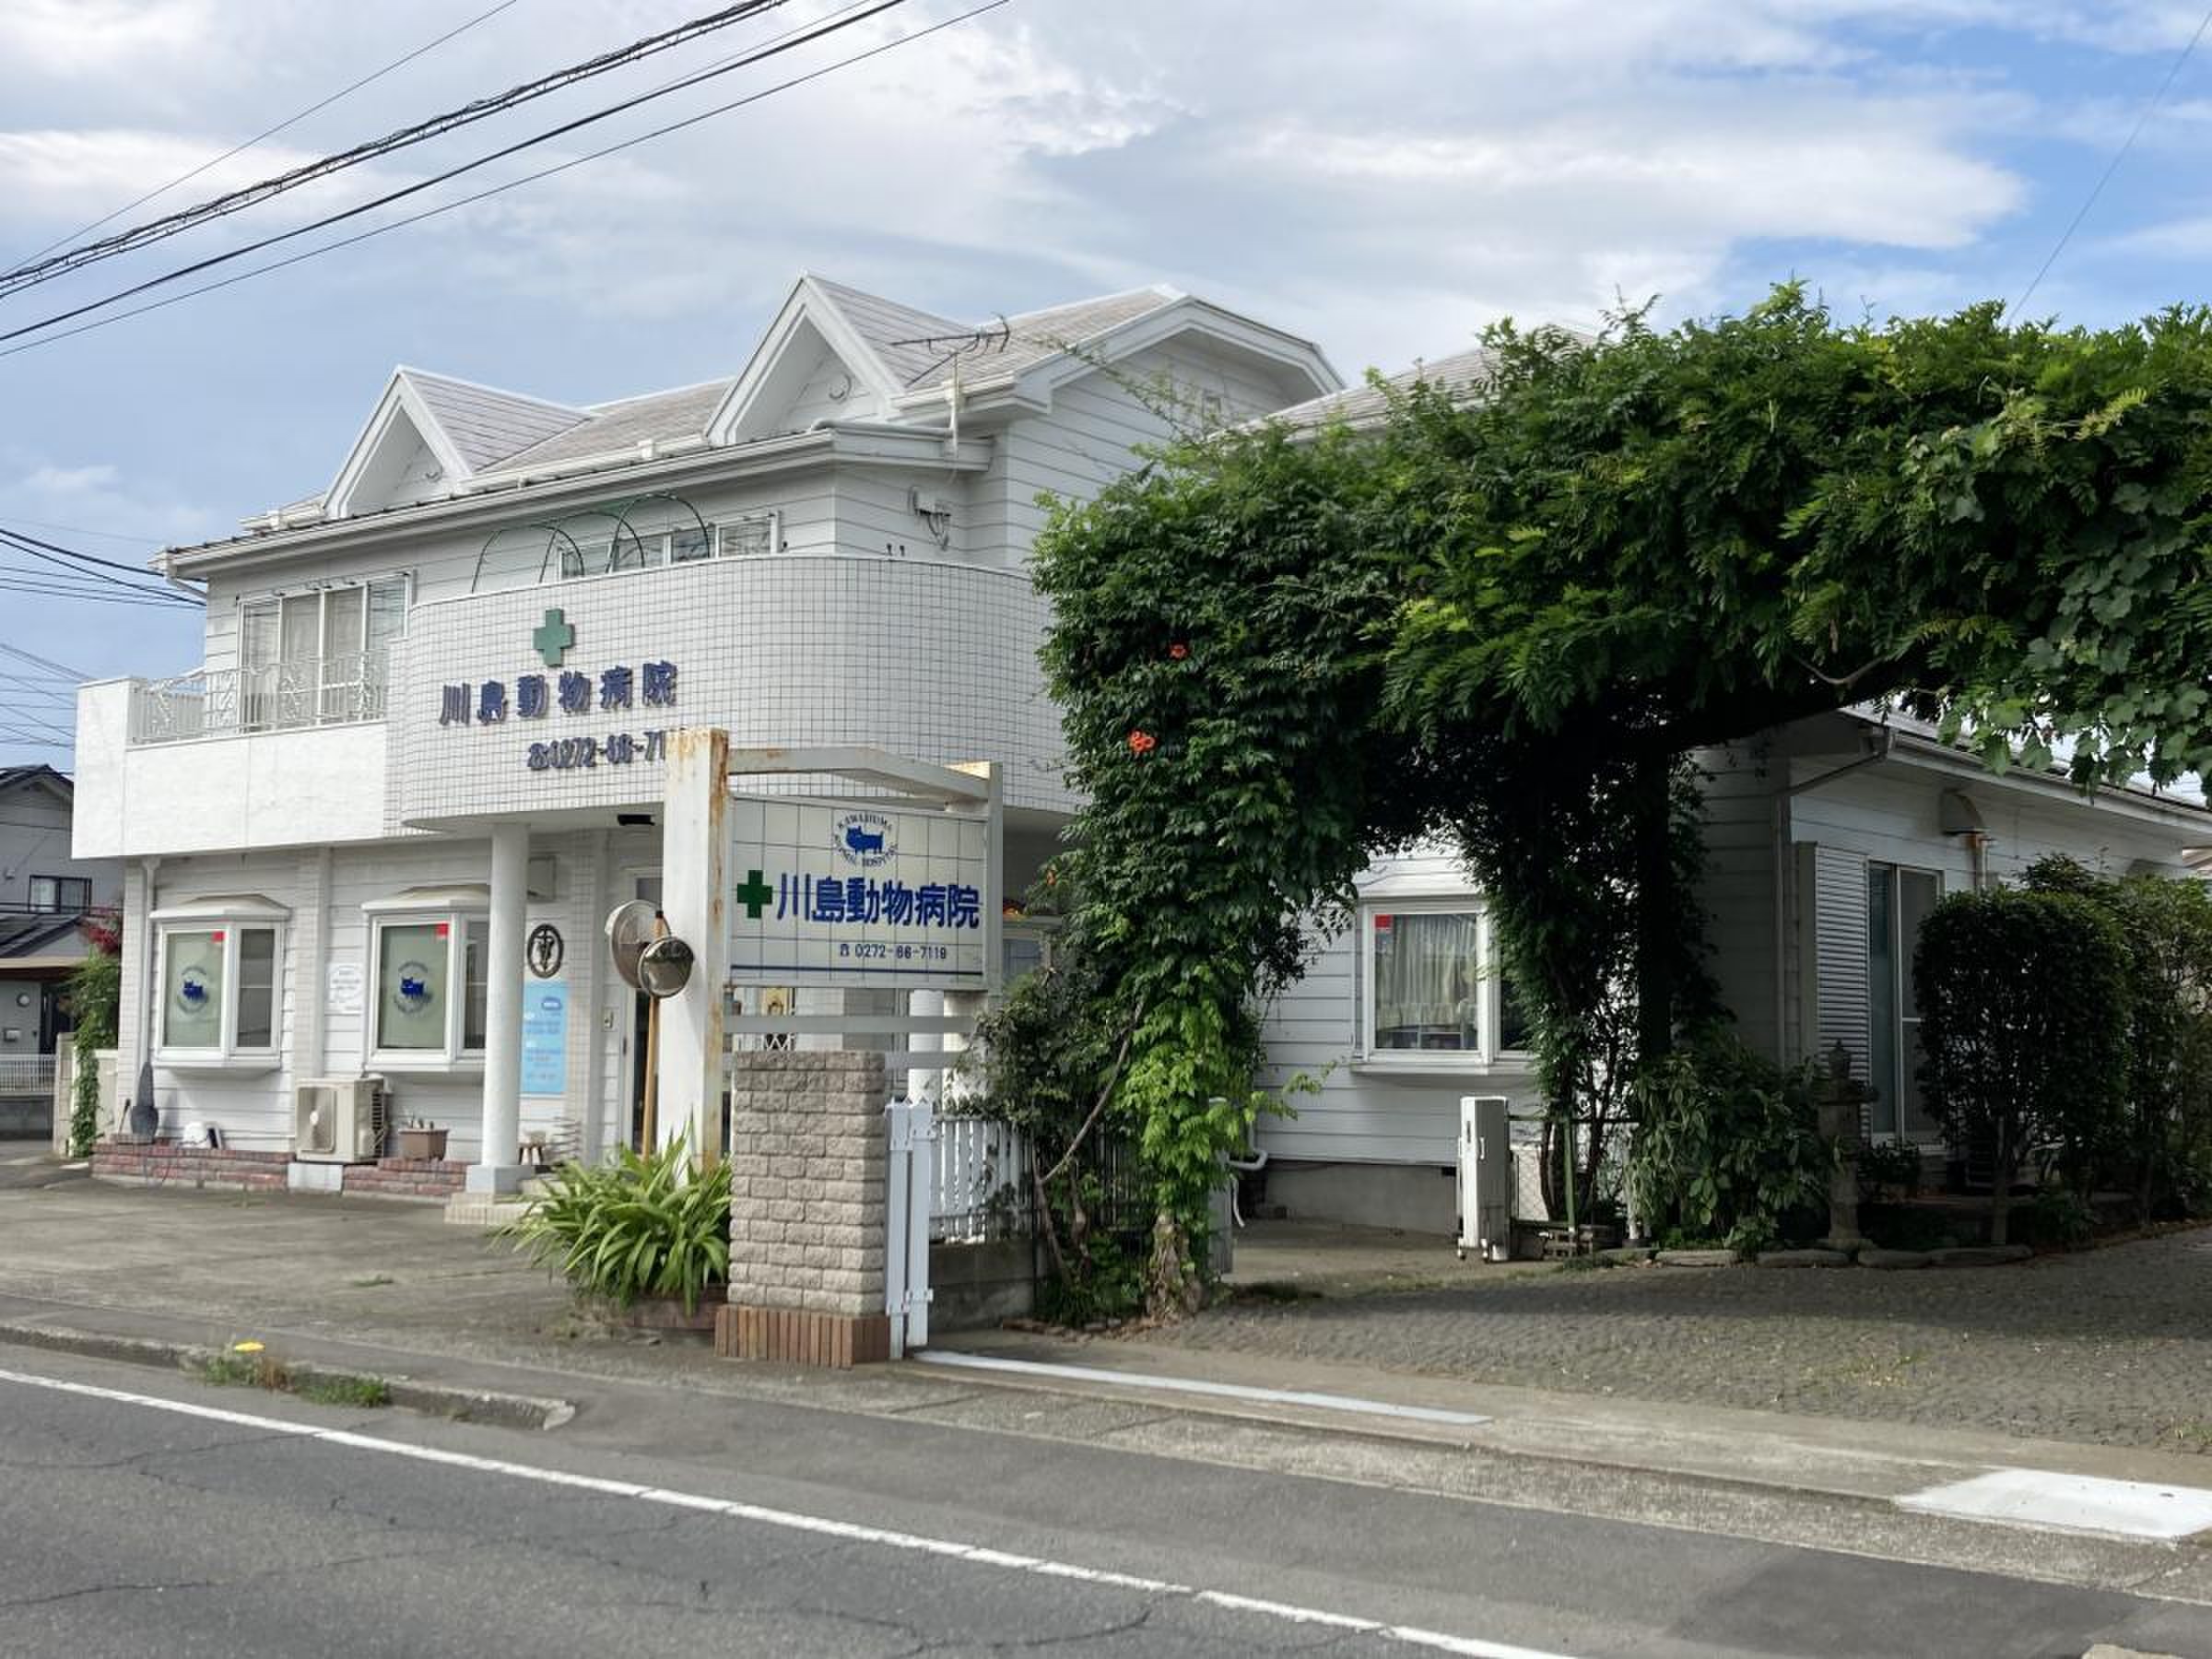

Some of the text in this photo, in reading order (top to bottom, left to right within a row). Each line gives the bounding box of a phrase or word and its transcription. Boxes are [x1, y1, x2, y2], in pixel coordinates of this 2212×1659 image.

[440, 660, 678, 726] 川島動物病院
[777, 872, 981, 929] 川島動物病院
